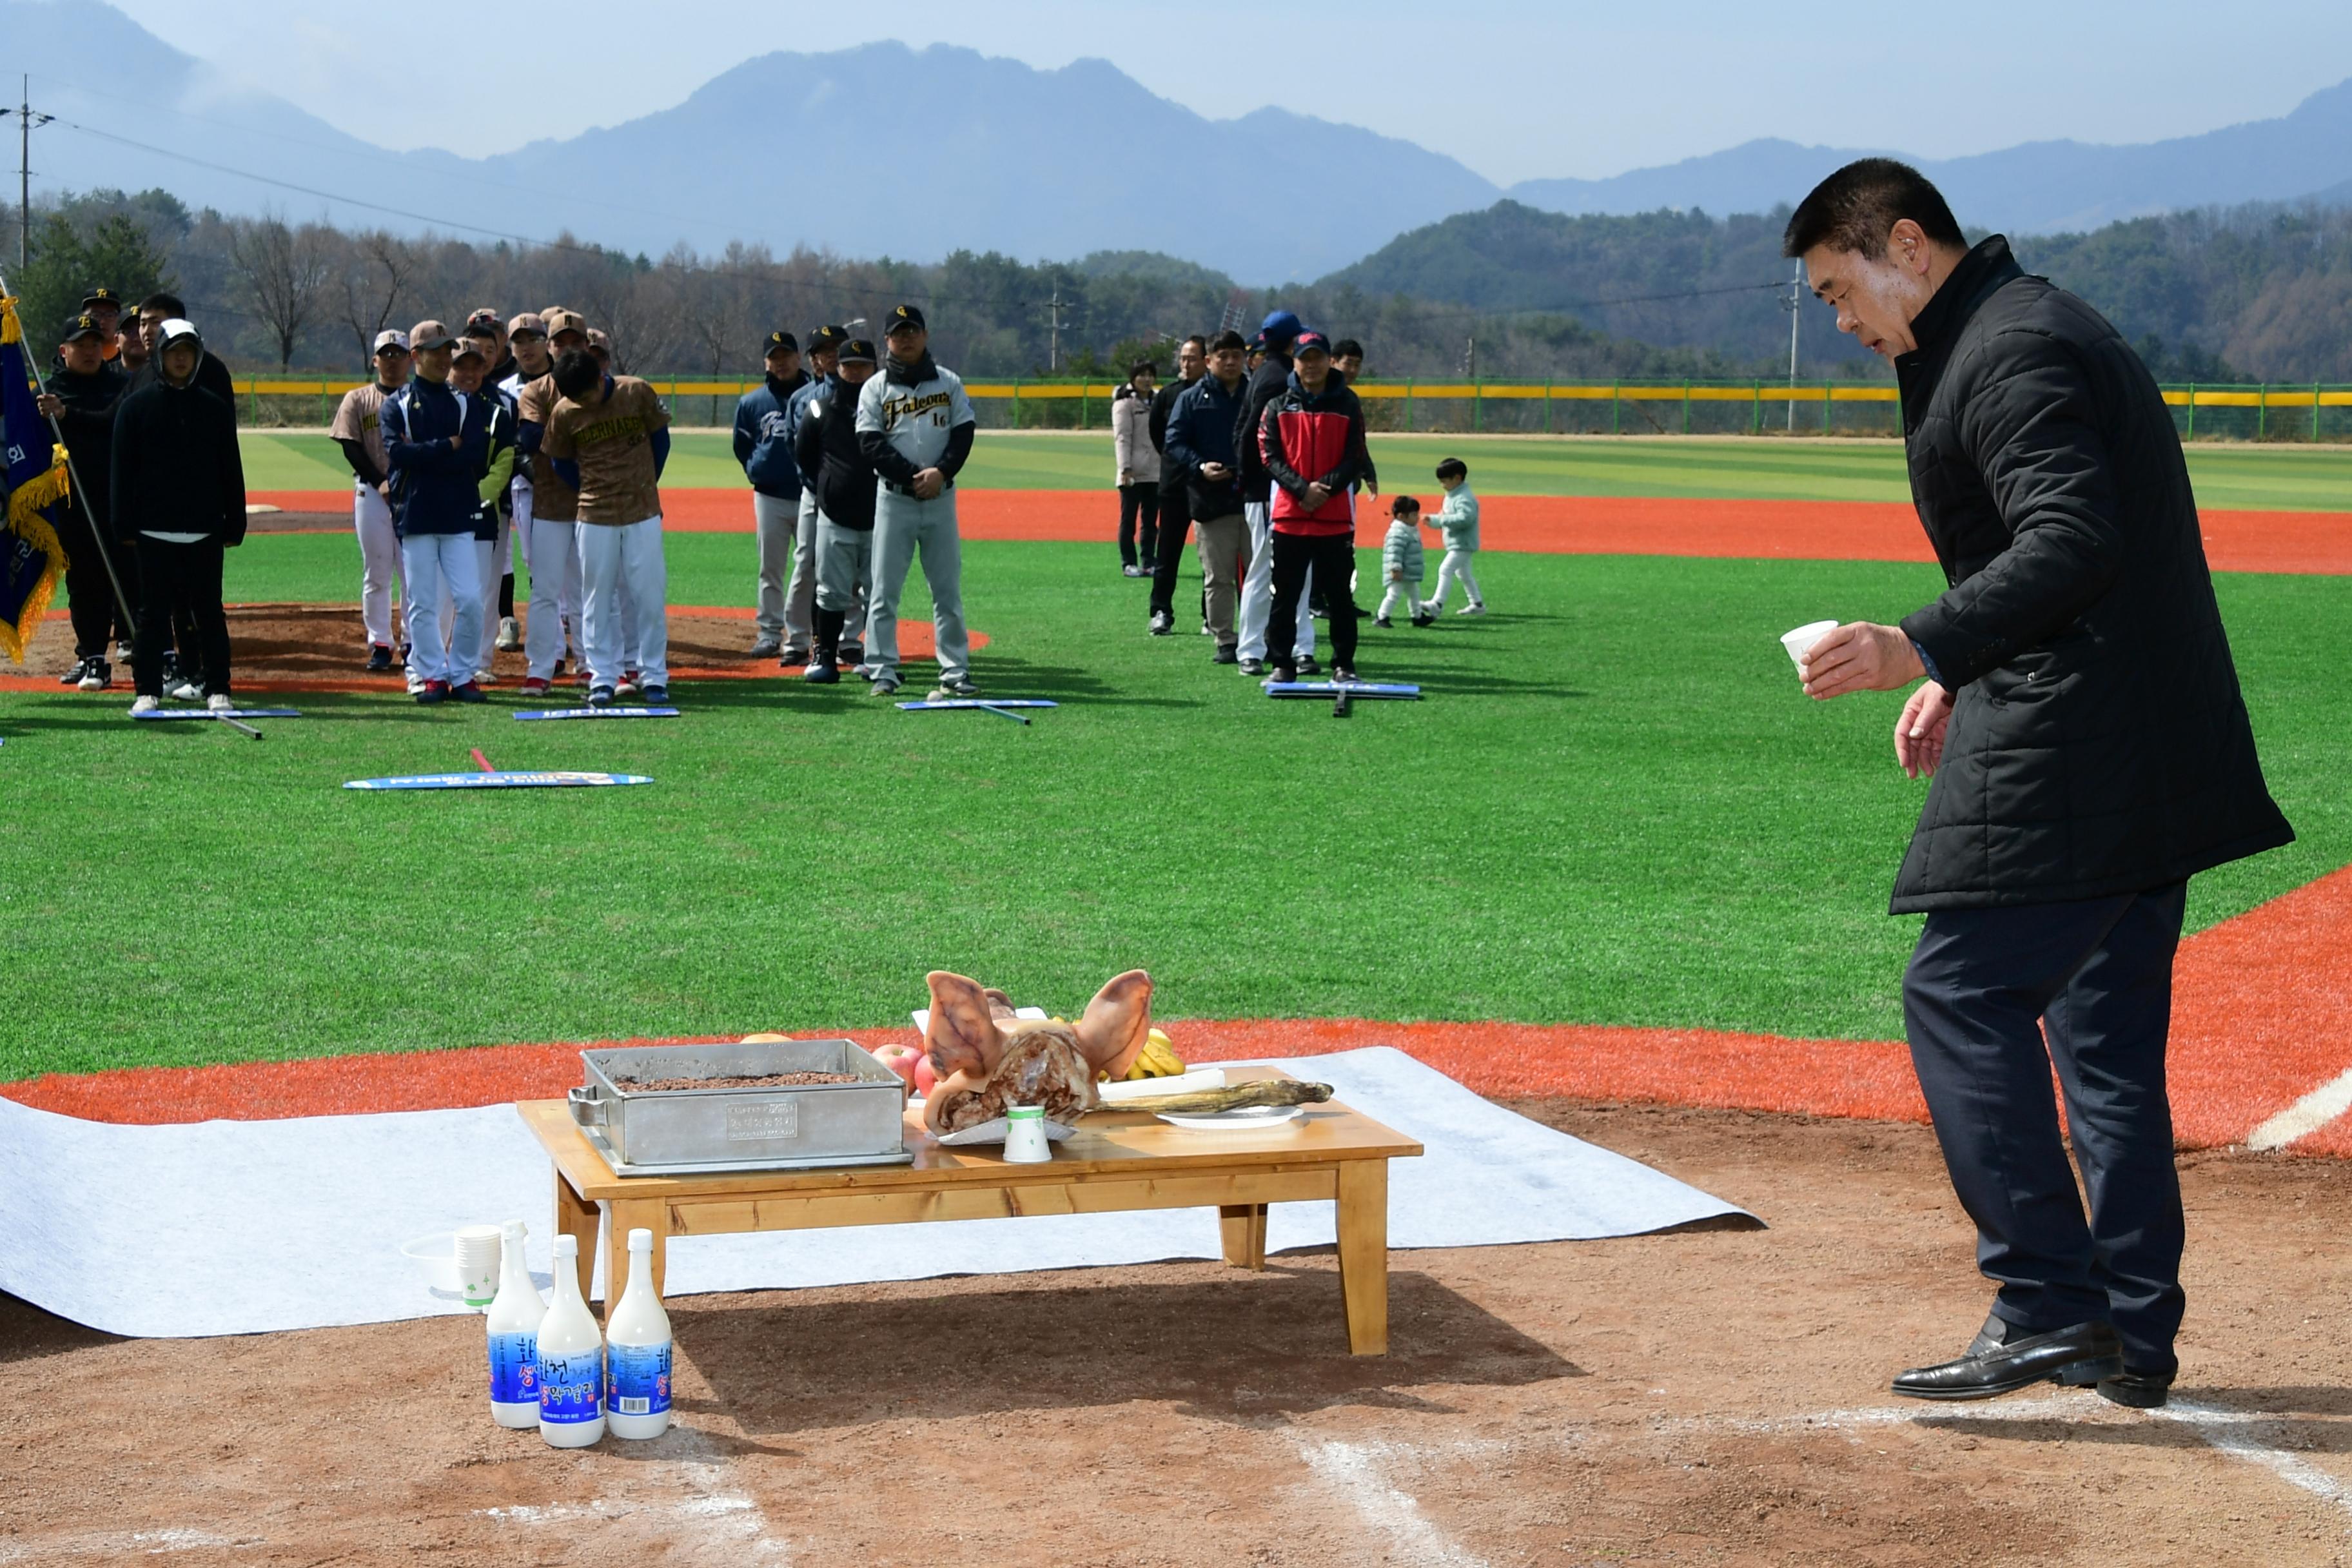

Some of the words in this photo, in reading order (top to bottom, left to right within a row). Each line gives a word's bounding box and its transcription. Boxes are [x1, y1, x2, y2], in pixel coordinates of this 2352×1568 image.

[362, 413, 380, 432] MIL
[883, 391, 951, 431] Falcons
[932, 413, 946, 427] 16
[515, 1337, 536, 1364] 화
[654, 1347, 671, 1375] 화
